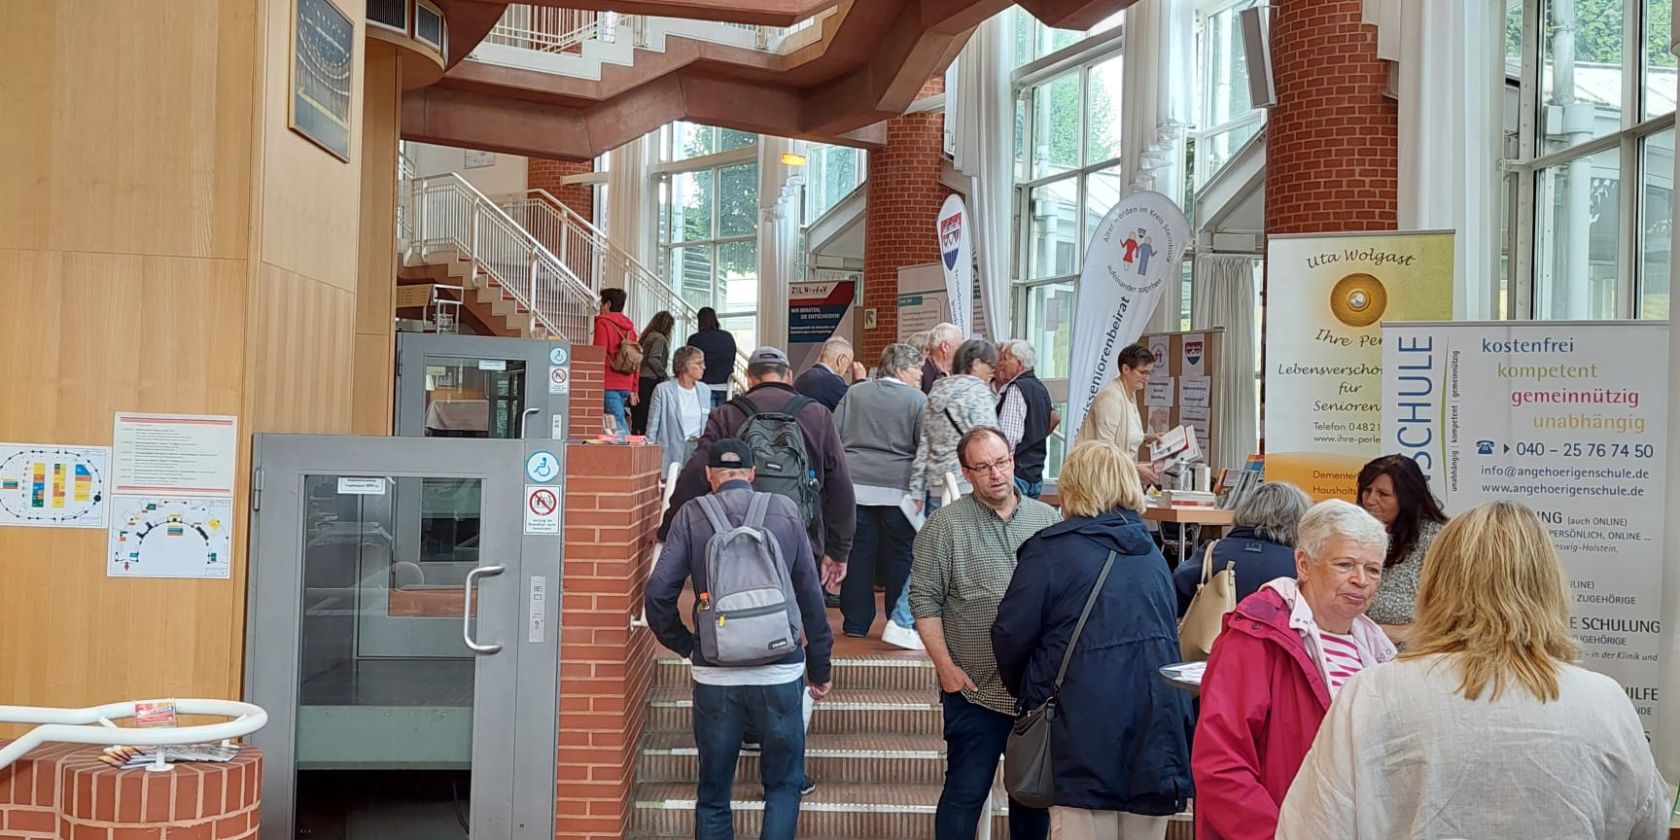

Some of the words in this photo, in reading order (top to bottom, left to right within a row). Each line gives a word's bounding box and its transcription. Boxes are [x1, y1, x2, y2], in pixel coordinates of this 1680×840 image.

[1306, 252, 1341, 269] Uta
[1344, 248, 1416, 266] Wolgast
[1314, 328, 1353, 347] Ihre
[1482, 337, 1574, 353] kostenfrei
[1498, 363, 1598, 382] kompetent
[1313, 400, 1382, 411] Senioren
[1511, 388, 1639, 408] gemeinnützig
[1397, 336, 1432, 481] SCHULE
[1313, 422, 1346, 431] Telefon
[1348, 422, 1381, 431] 04821
[1451, 405, 1460, 443] kompetent
[1533, 413, 1645, 434] unabhängig
[1516, 442, 1545, 456] 040
[1563, 442, 1582, 457] 25
[1587, 443, 1606, 457] 76
[1611, 444, 1630, 458] 74
[1634, 444, 1654, 458] 50
[1481, 465, 1649, 480] info@angehoerigenschule.de
[1482, 484, 1644, 497] www.angehoerigenschule.de
[1536, 510, 1563, 524] NG
[1567, 516, 1591, 526] (auch
[1593, 517, 1628, 527] ONLINE)
[1608, 531, 1641, 541] ONLINE
[1570, 580, 1595, 590] LINE)
[1576, 593, 1637, 605] ZUGEHÖRIGE
[1581, 617, 1661, 634] SCHULUNG
[1573, 634, 1627, 646] UGEHÖRIGE
[1602, 651, 1616, 659] der
[1616, 651, 1640, 661] Klinik
[1642, 653, 1658, 662] und
[1625, 687, 1659, 701] ILFE
